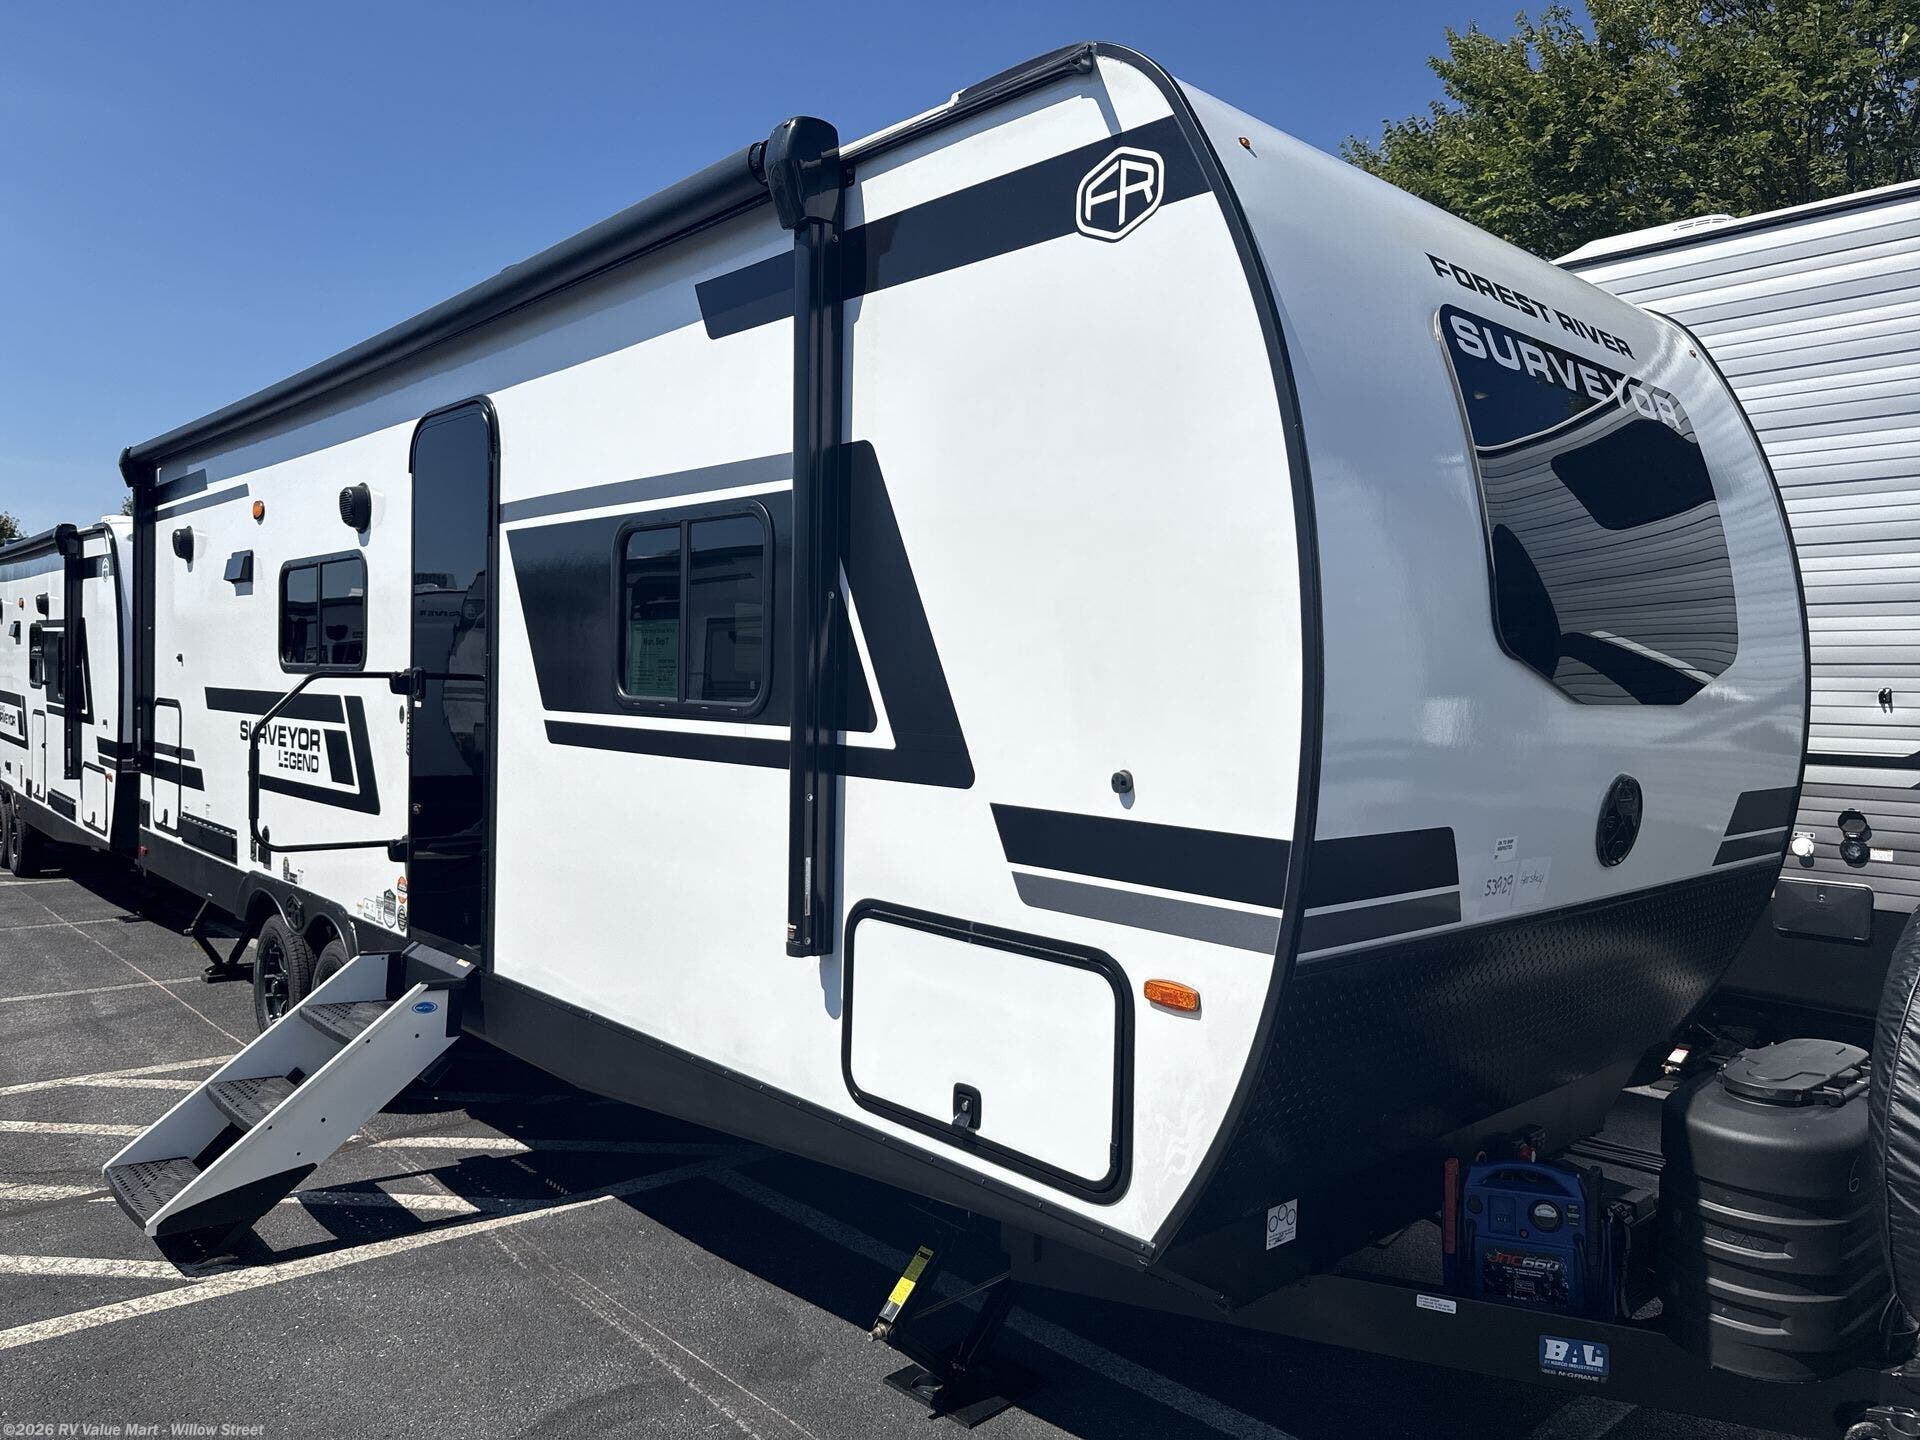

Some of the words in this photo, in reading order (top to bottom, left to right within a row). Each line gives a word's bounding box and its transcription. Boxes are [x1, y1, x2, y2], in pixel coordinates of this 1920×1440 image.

[1084, 158, 1155, 226] FR
[1424, 251, 1551, 324] FOREST
[1552, 308, 1636, 361] RIVER
[1449, 314, 1682, 430] SURVEYOR
[278, 749, 320, 774] LEGEND
[1484, 874, 1514, 897] 53929
